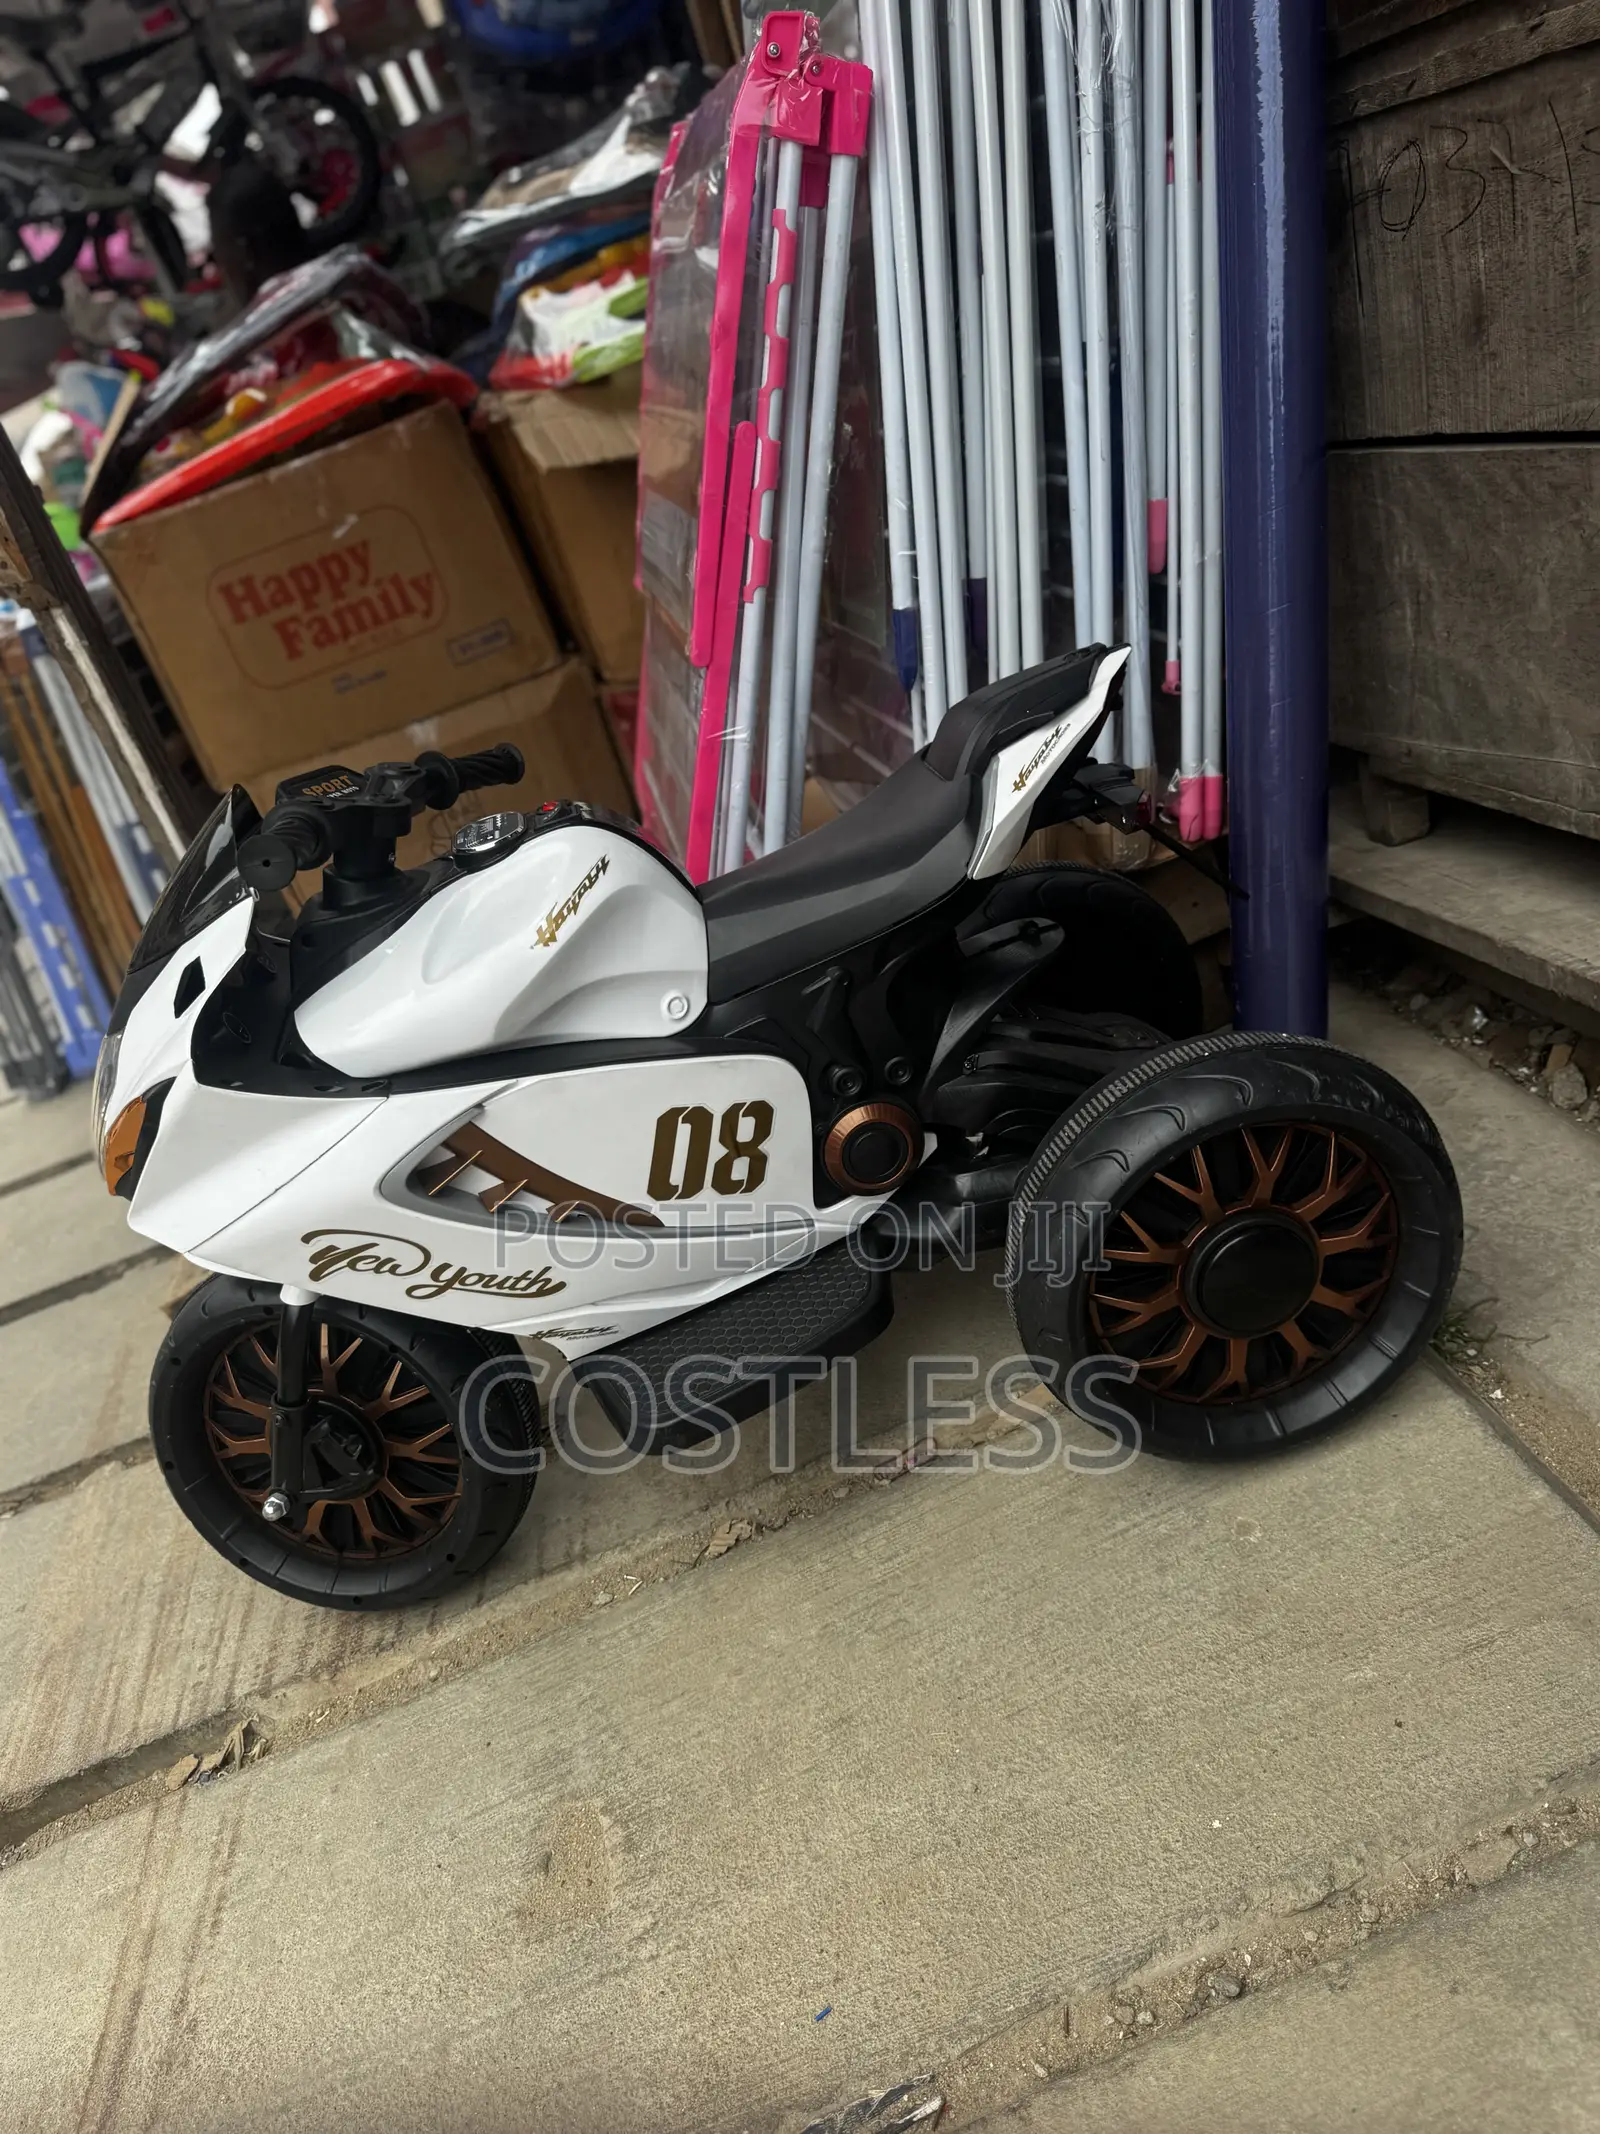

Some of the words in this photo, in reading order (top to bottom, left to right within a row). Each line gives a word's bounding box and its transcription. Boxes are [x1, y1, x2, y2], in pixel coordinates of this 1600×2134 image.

[217, 539, 370, 624] Happy
[273, 572, 434, 661] Family
[303, 776, 353, 796] SPORT
[647, 1100, 775, 1202] 08
[405, 1265, 567, 1300] youth
